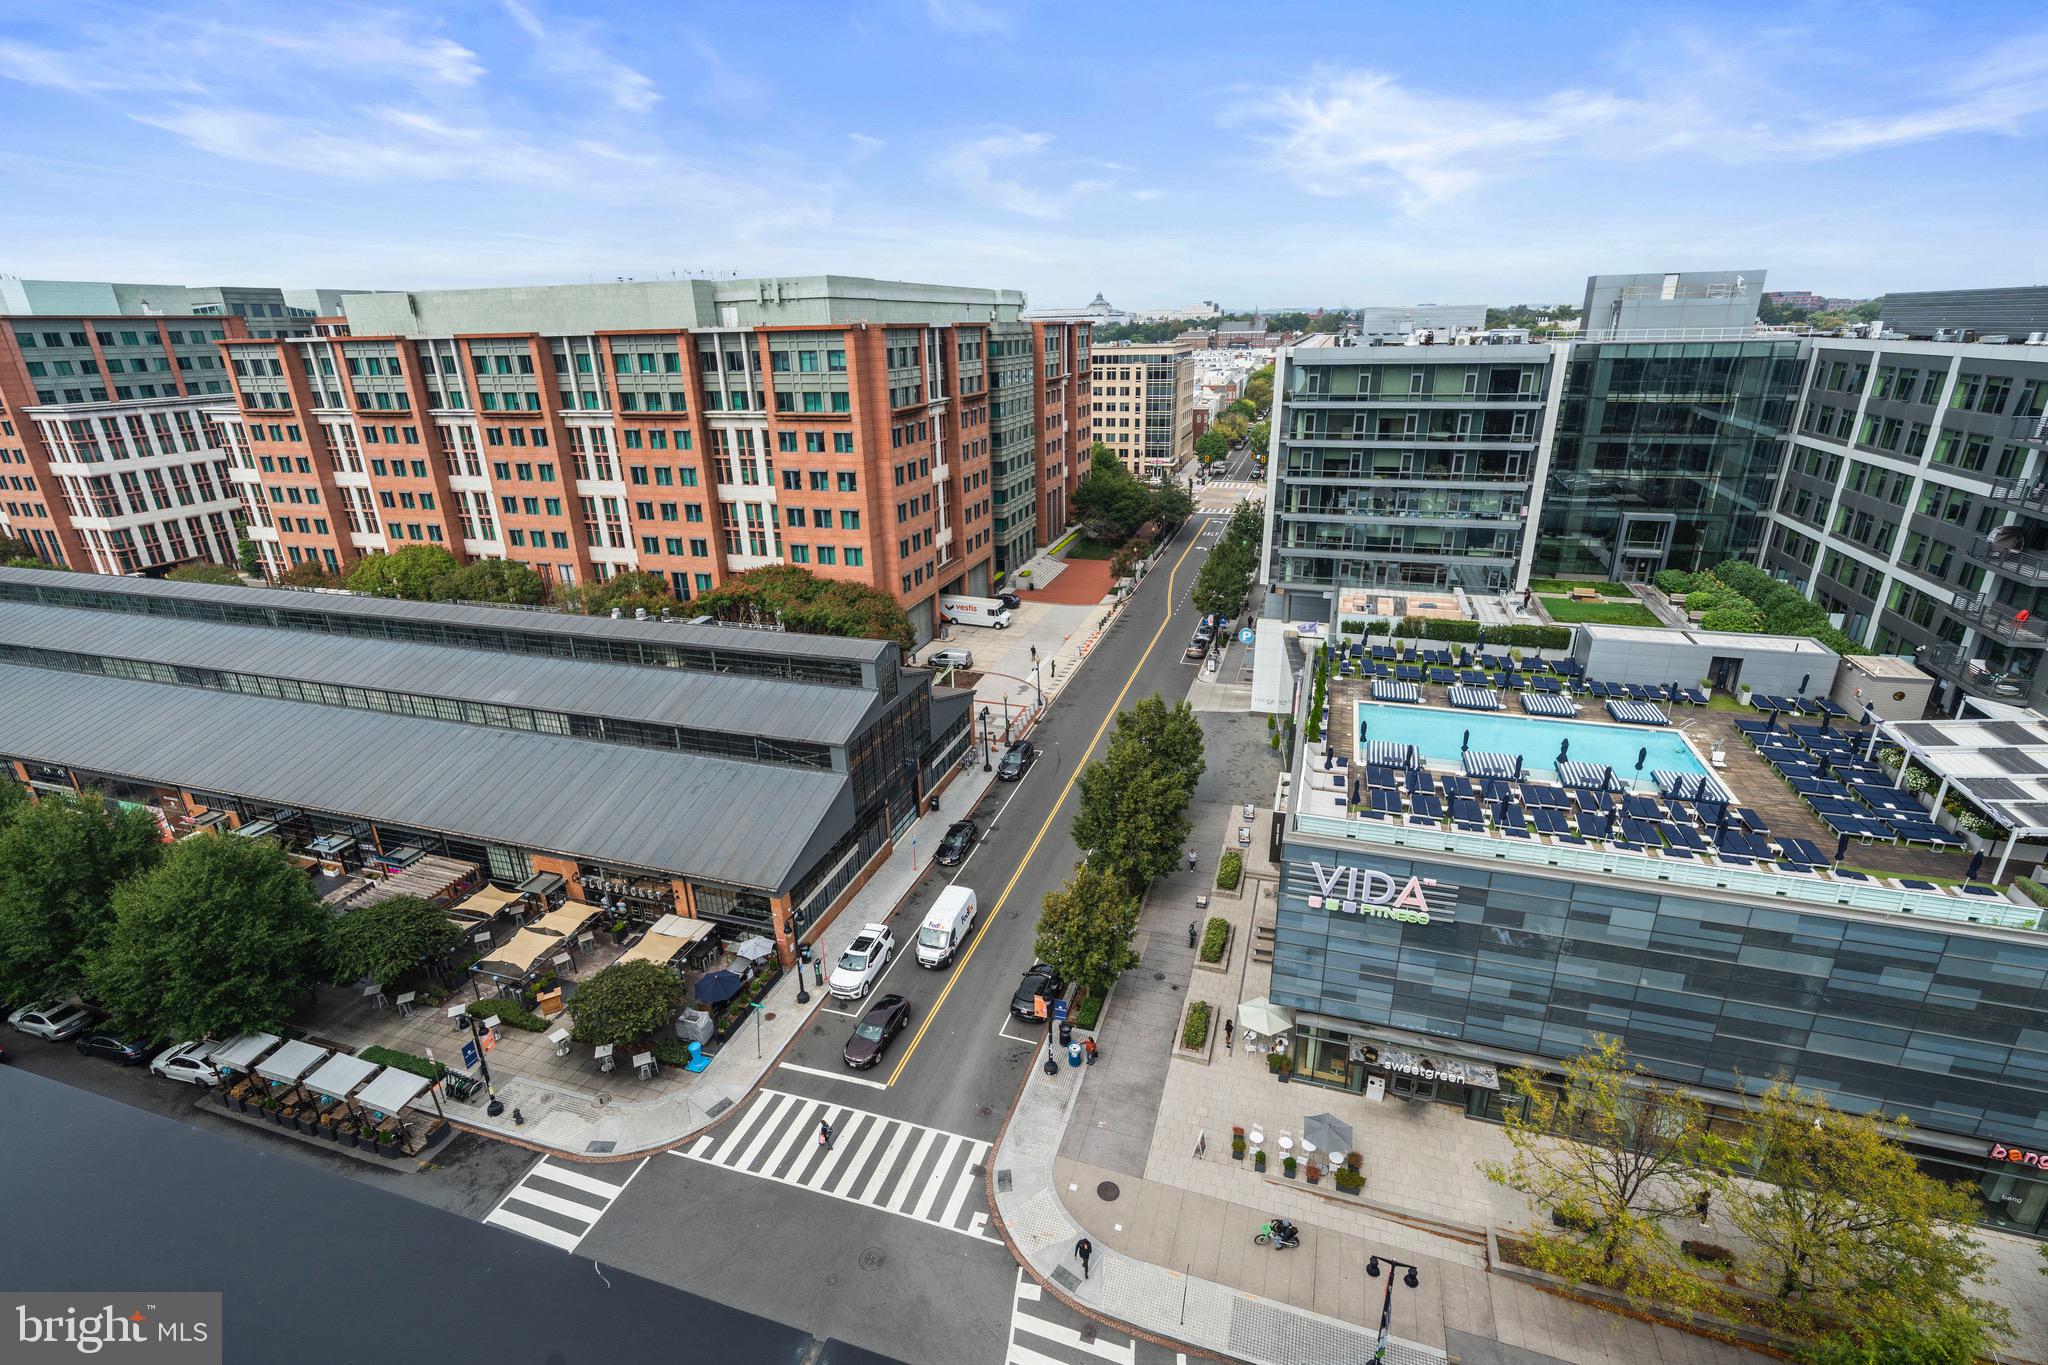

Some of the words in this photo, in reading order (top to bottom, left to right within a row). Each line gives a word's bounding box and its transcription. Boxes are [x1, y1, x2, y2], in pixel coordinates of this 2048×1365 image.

[956, 604, 977, 612] vestis
[580, 877, 662, 901] BLUEJACKET
[1311, 861, 1429, 911] VIDA
[961, 904, 974, 924] FedEx
[1360, 903, 1430, 925] FITNESS
[929, 921, 945, 929] FedEx
[1384, 1060, 1465, 1084] sweetgreen
[2002, 1193, 2023, 1204] bang
